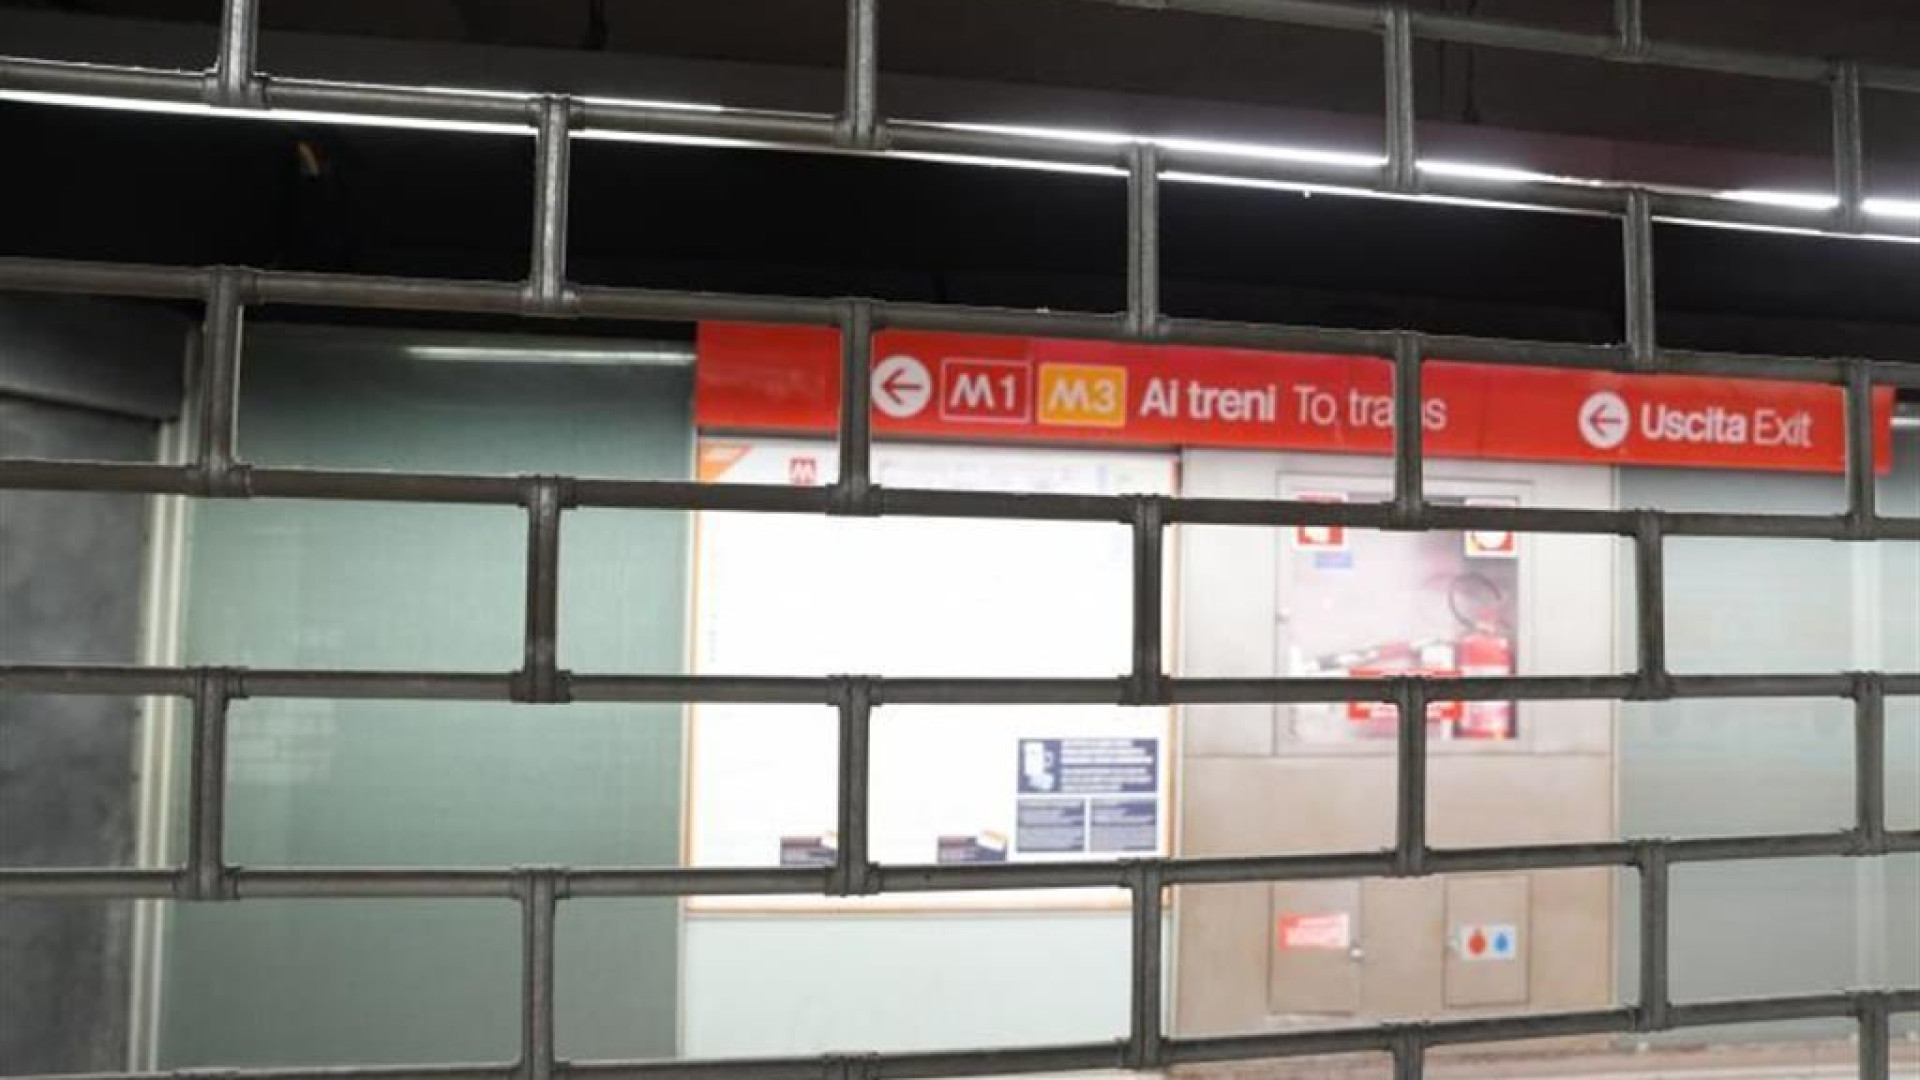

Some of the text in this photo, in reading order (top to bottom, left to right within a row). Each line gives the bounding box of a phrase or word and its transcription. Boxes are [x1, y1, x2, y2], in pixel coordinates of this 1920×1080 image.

[949, 373, 1448, 430] M1 M3 Ai treni To tras
[1640, 404, 1812, 448] Uscita Exit
